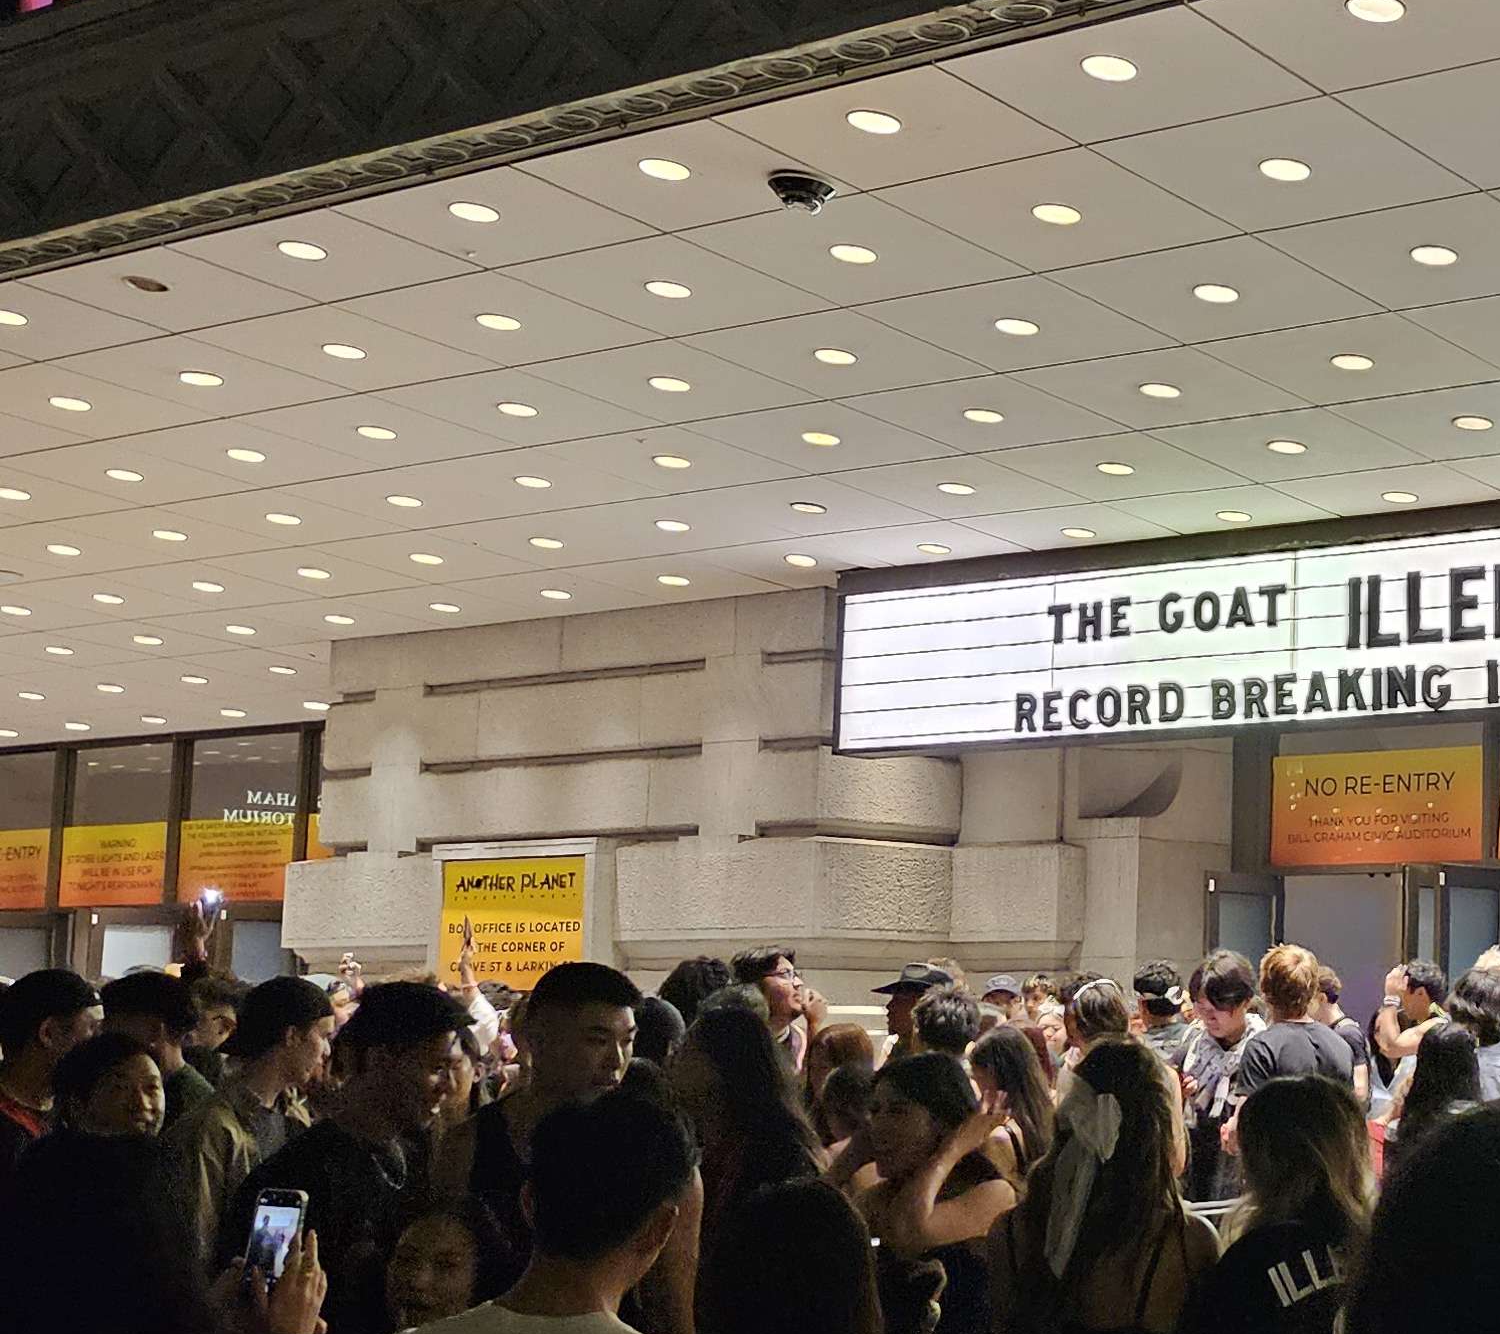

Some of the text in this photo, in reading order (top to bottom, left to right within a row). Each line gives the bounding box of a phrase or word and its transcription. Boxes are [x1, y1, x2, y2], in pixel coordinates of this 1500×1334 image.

[1048, 596, 1131, 644] THE
[1159, 584, 1287, 633] GOAT
[1014, 682, 1185, 732] RECORD
[1211, 664, 1451, 720] BREAKING
[1304, 771, 1456, 798] NO RE-ENTRY
[1309, 812, 1449, 828] THANK YOU FOR VISITING
[1398, 827, 1471, 841] AUDITORIUM
[0, 845, 42, 861] -ENTRY
[456, 872, 577, 893] ANOTHER PLANET
[449, 921, 580, 934] BO OFFICE IS LOCATED
[478, 941, 565, 953] THE CORNER OF
[489, 961, 502, 972] ST
[505, 961, 512, 972] &
